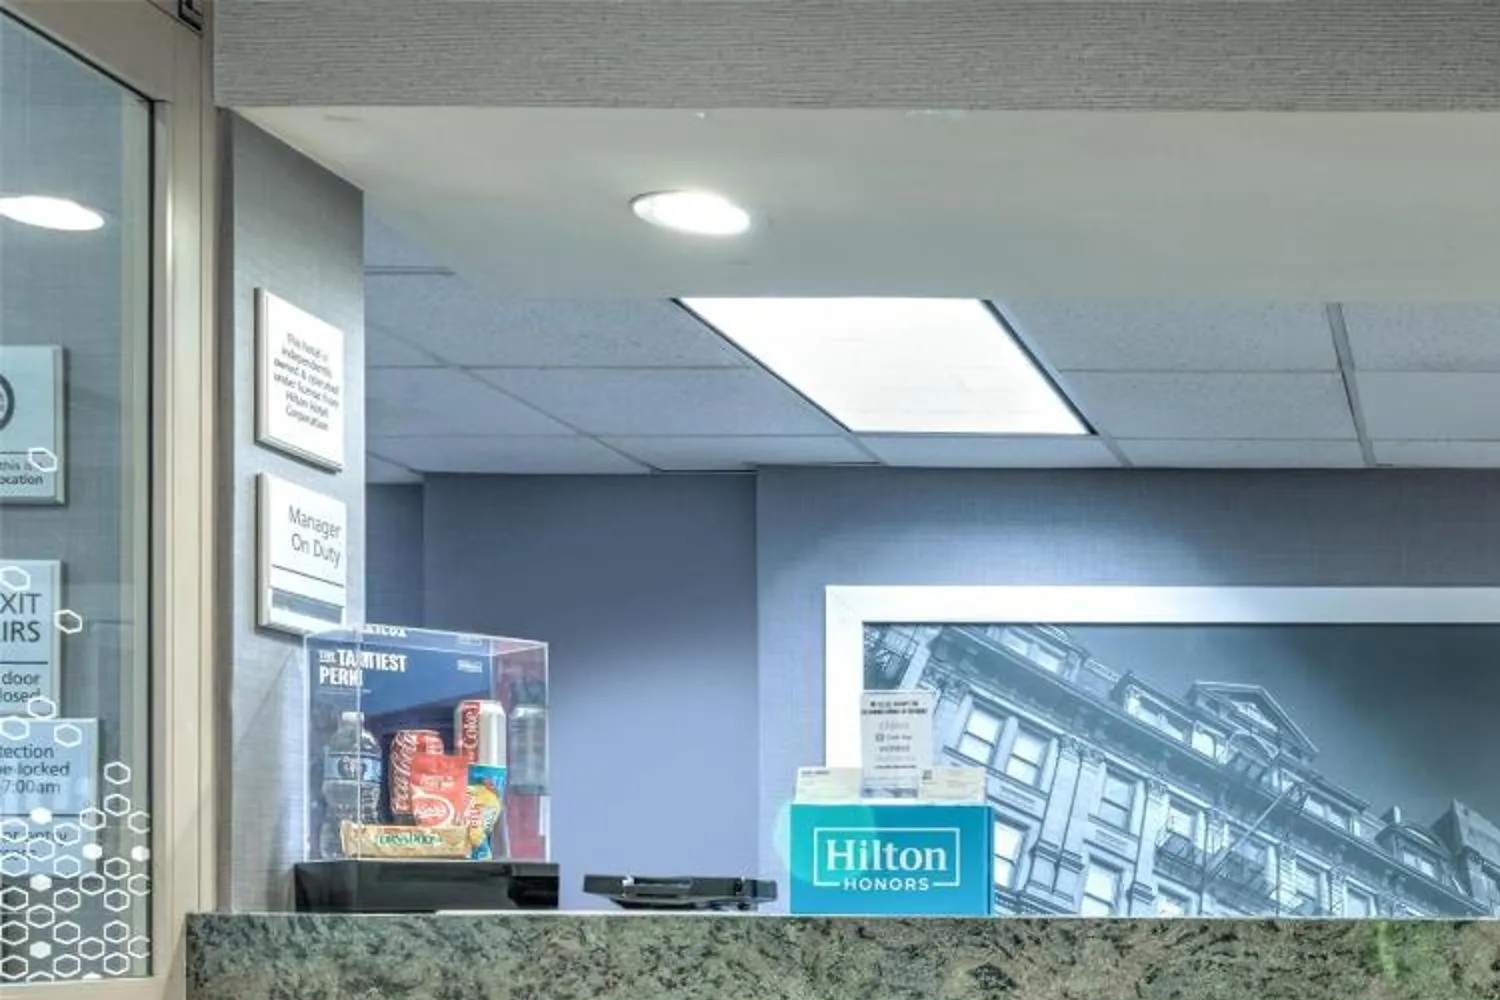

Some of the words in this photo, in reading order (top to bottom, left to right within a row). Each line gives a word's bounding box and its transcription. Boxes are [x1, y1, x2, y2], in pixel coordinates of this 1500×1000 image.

[289, 504, 342, 540] Manager
[291, 532, 310, 553] On
[313, 539, 341, 569] Duty
[1, 670, 41, 685] door
[18, 761, 71, 776] locked
[826, 839, 947, 872] Hilton
[843, 877, 930, 892] HONORS
